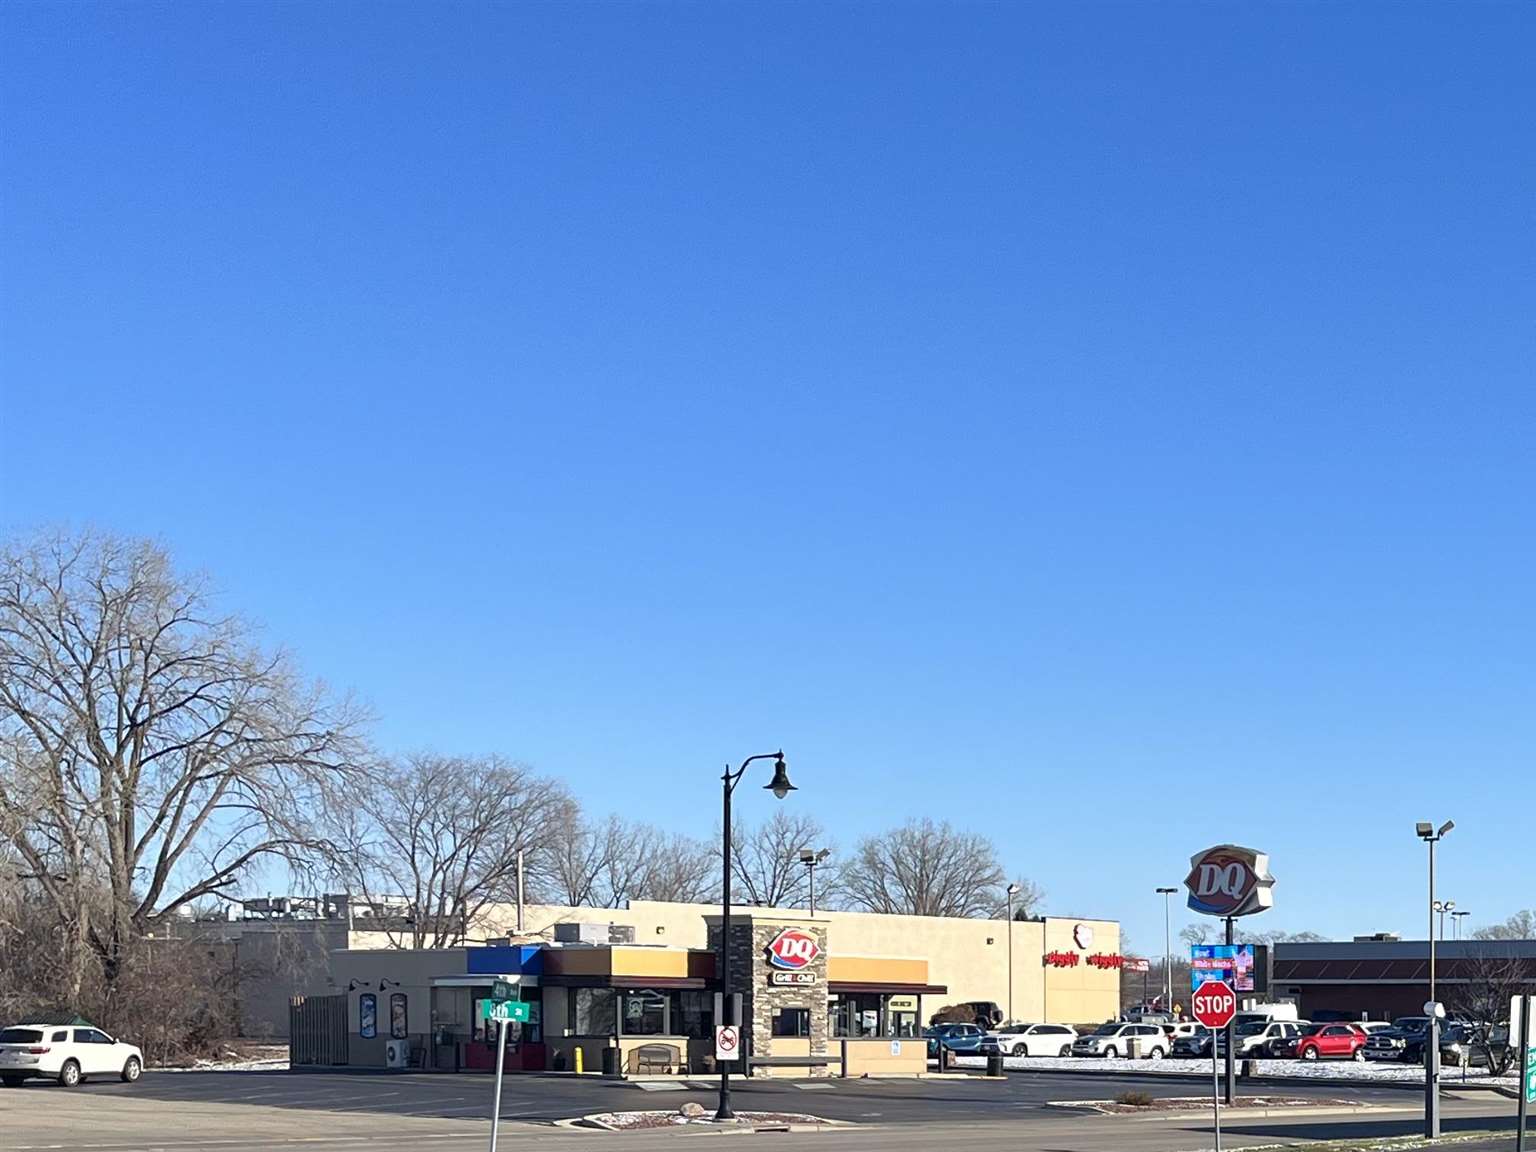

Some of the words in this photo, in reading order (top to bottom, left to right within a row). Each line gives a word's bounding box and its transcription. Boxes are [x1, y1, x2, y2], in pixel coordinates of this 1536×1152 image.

[1197, 862, 1248, 900] DQ
[780, 938, 814, 961] DQ
[1195, 995, 1233, 1014] STOP
